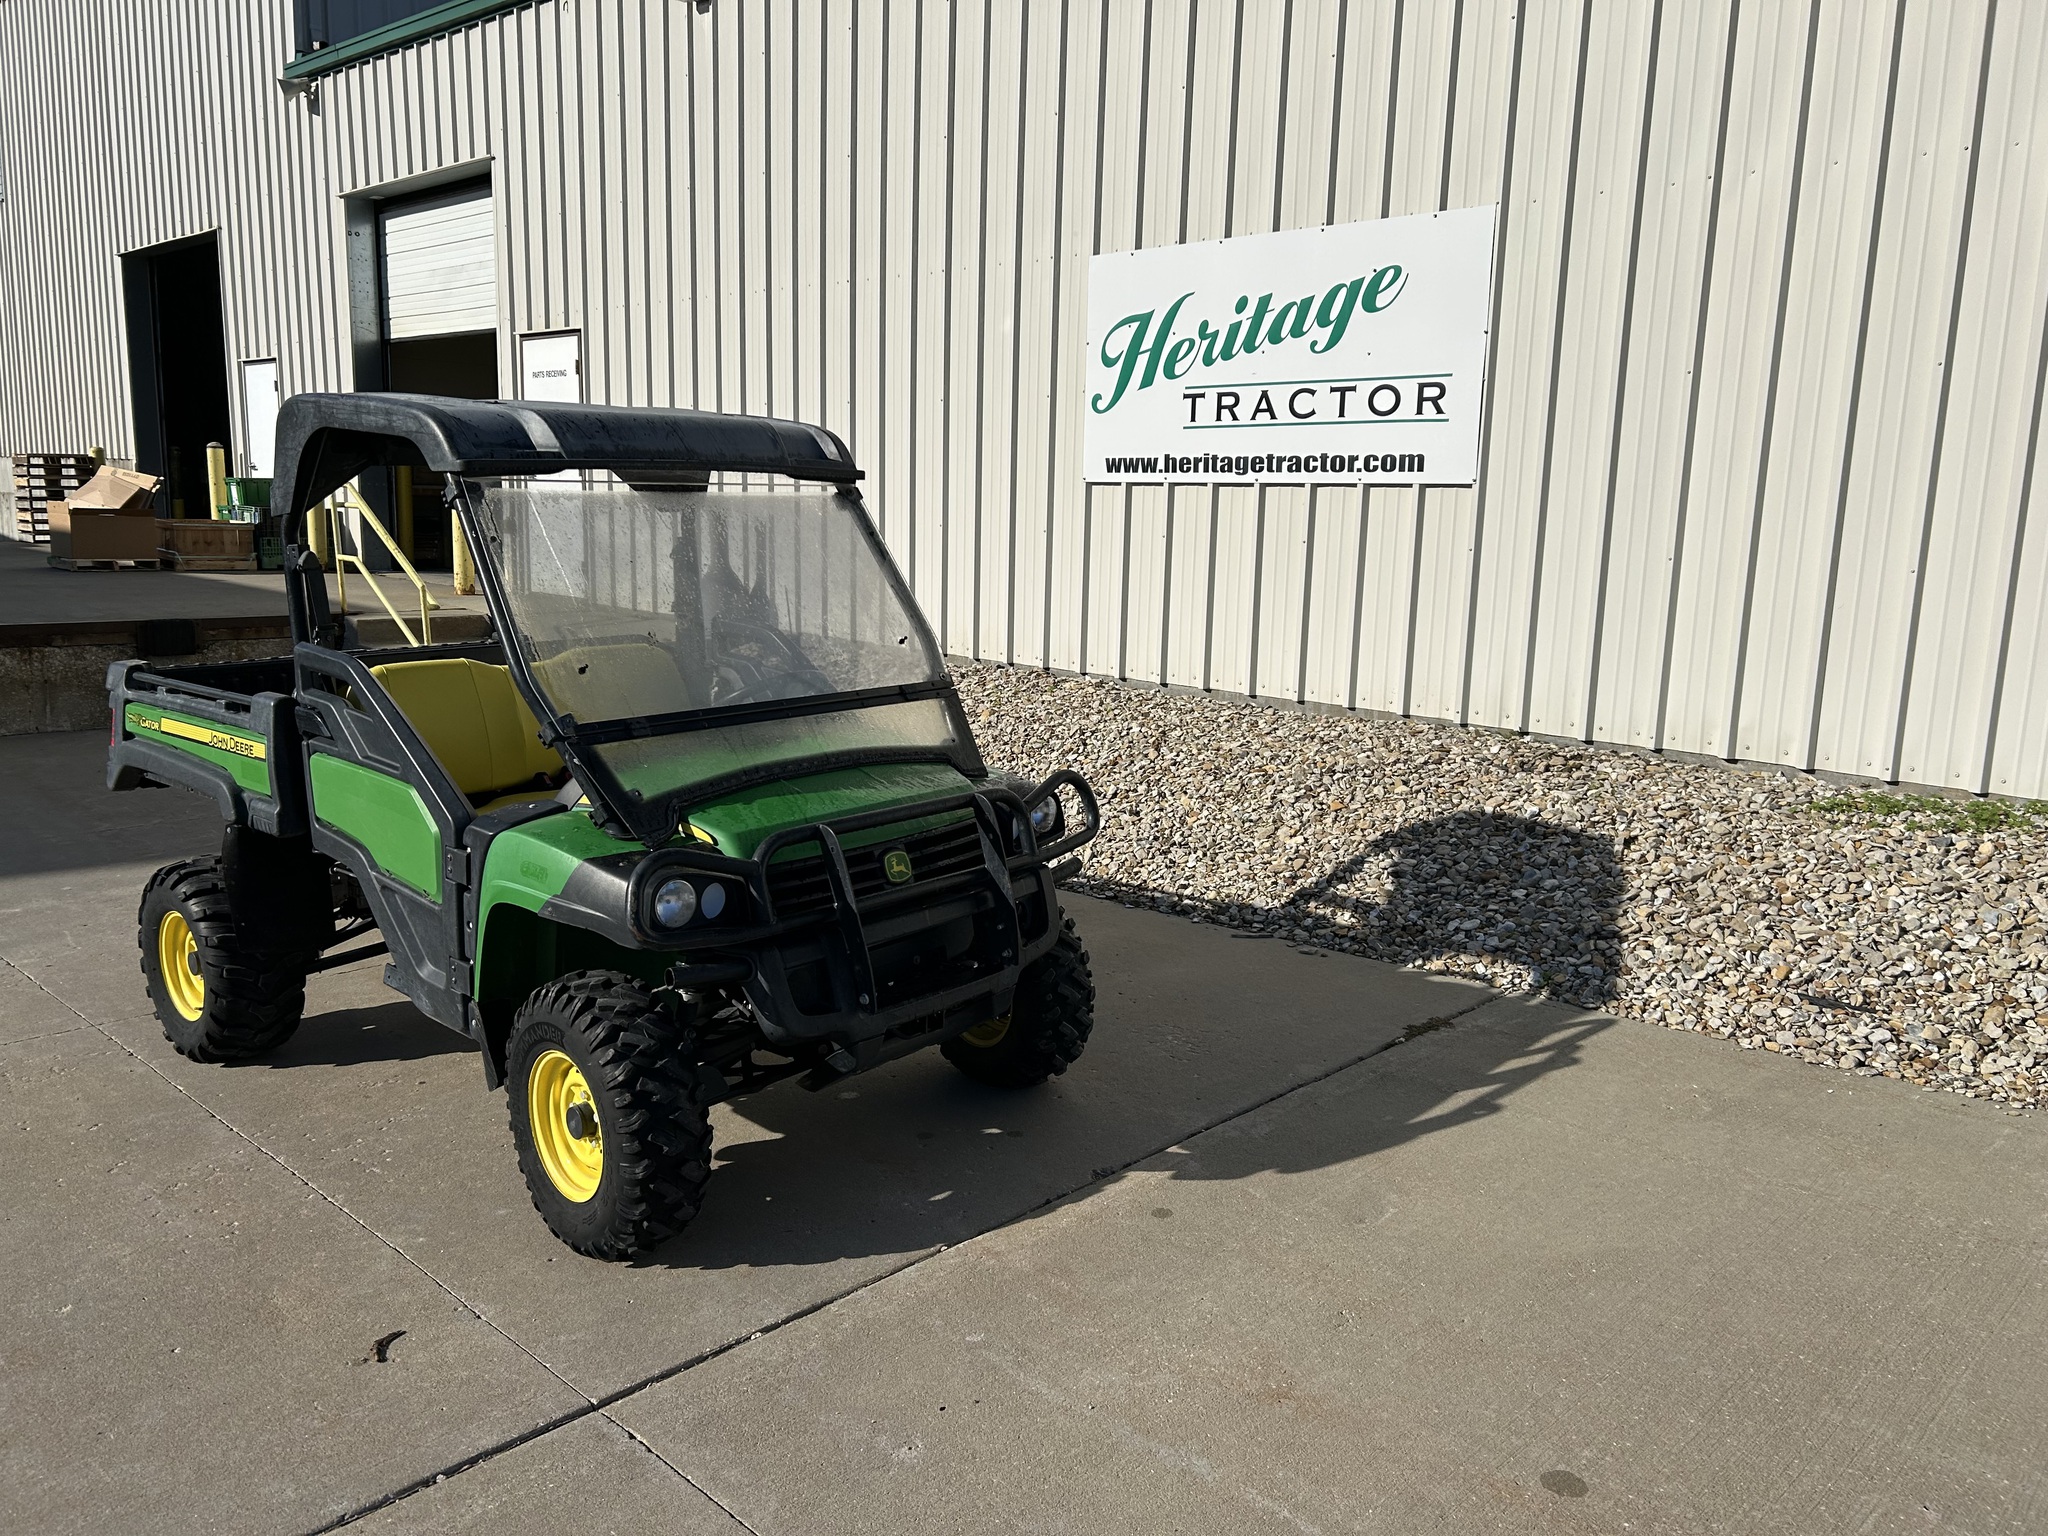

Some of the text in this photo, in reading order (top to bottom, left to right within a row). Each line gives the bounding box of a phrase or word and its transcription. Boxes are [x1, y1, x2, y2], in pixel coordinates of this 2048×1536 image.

[1091, 264, 1409, 414] Heritage
[546, 369, 567, 378] RECEIVING
[1183, 382, 1446, 422] TRACTOR
[1105, 453, 1425, 476] www.heritagetractor.com
[140, 717, 159, 731] GATOR
[208, 732, 254, 755] JOHN DEERE
